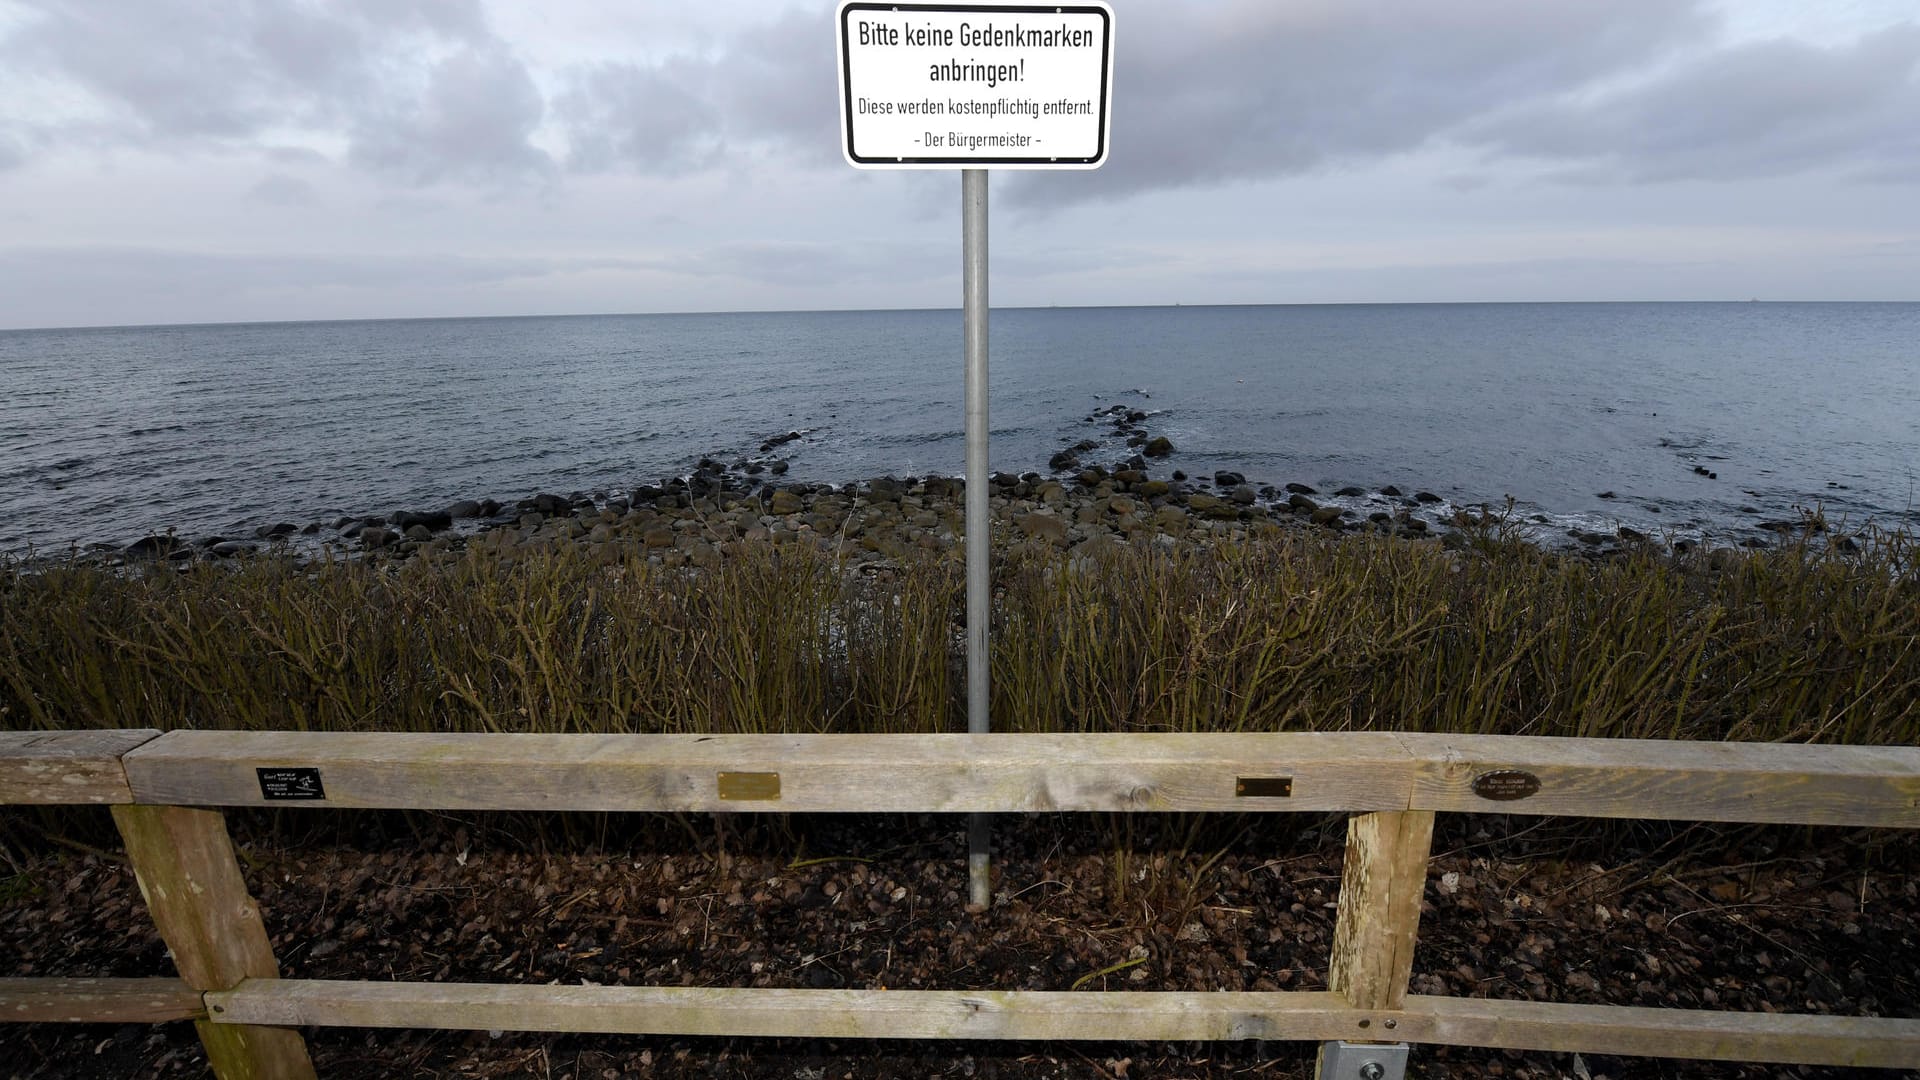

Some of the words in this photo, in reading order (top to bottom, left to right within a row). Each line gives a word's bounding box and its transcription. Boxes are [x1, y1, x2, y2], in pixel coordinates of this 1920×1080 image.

[859, 21, 898, 46] Bitte
[905, 22, 953, 47] keine
[960, 22, 1093, 47] Gedenkmarken
[930, 58, 1024, 88] anbringen!
[859, 97, 893, 114] Diese
[897, 98, 944, 115] werden
[948, 98, 1039, 119] kostenpflichtig
[1043, 98, 1093, 115] entfernt.
[925, 132, 944, 147] Der
[949, 131, 1032, 151] Bürgermeister
